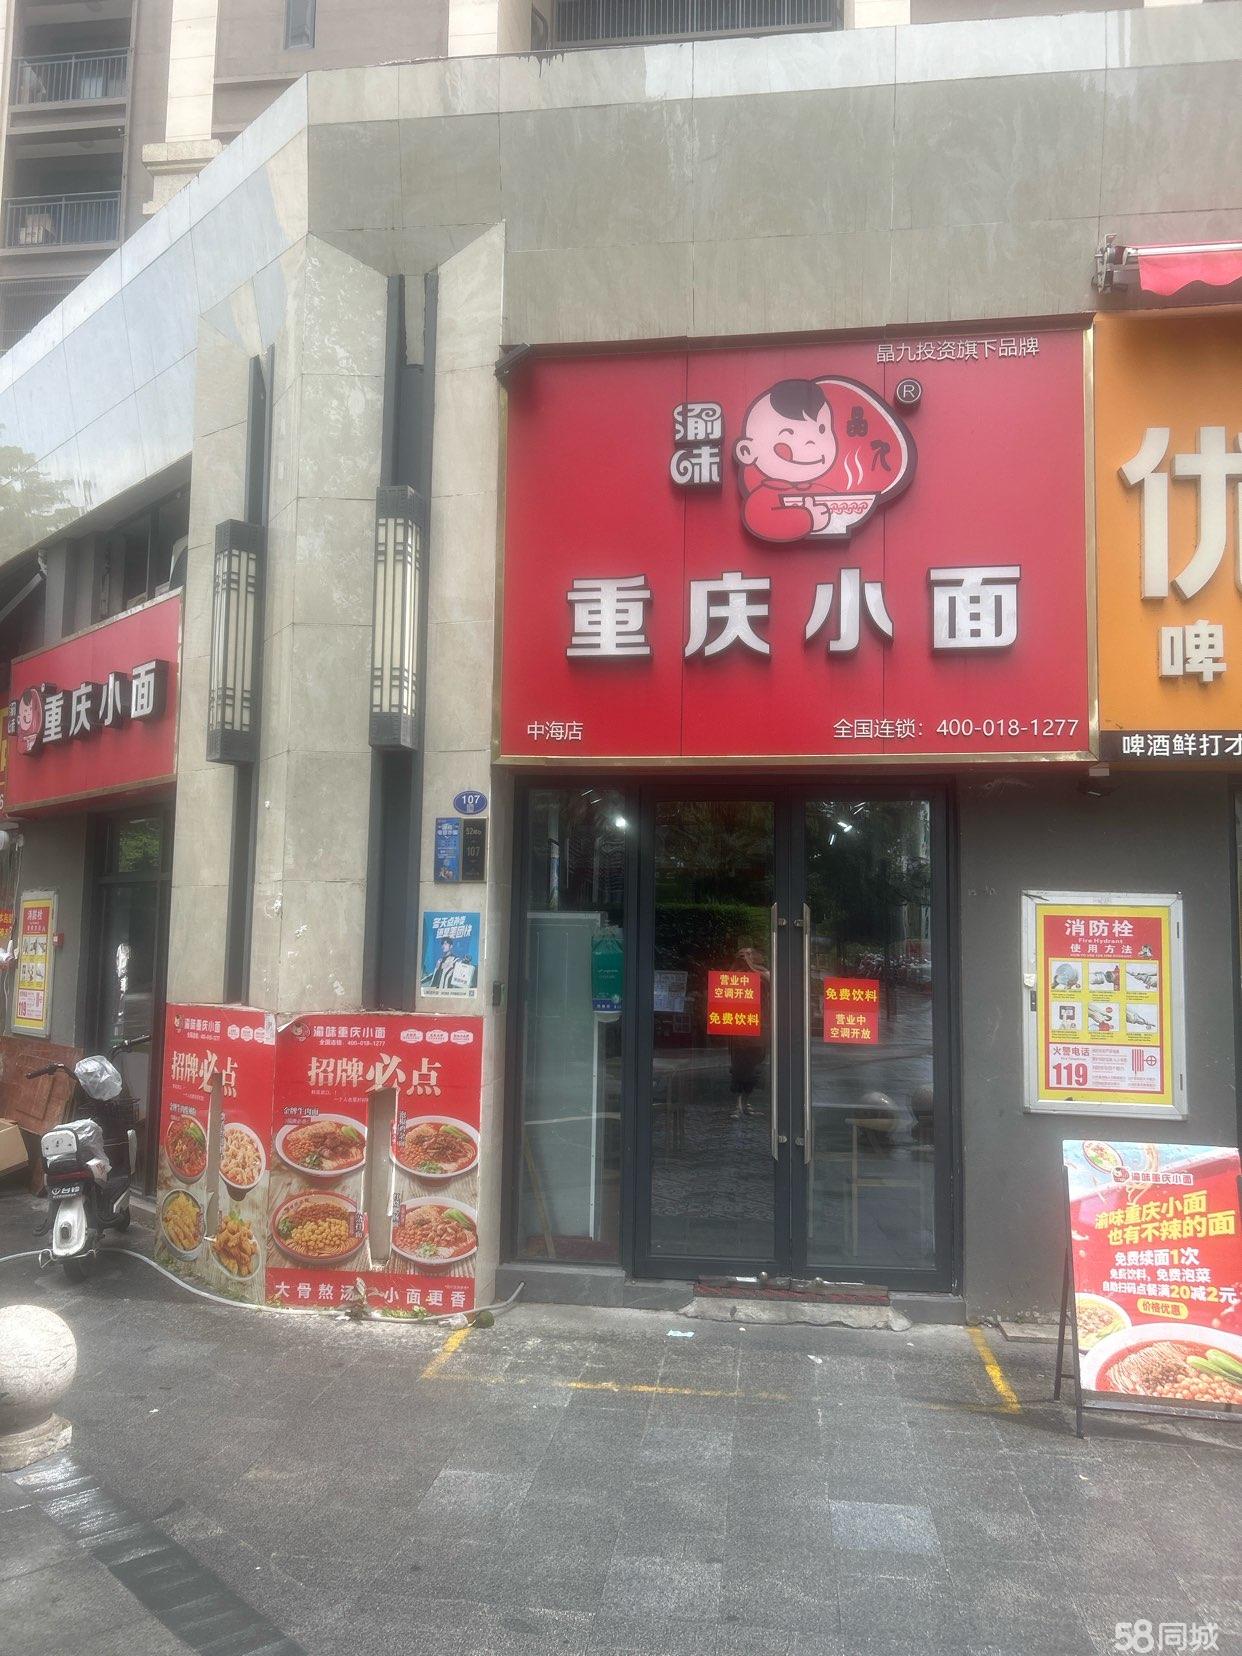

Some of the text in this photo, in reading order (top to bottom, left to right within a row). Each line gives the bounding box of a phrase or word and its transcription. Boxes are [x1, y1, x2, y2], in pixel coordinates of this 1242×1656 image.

[876, 337, 1041, 363] 晶九投资旗下品牌
[566, 567, 1021, 658] 重庆小面
[1159, 618, 1227, 683] 啤
[43, 661, 156, 743] 重庆小面
[527, 721, 583, 741] 中海店
[462, 794, 480, 804] 107
[1064, 918, 1134, 937] 消防栓
[1070, 943, 1133, 954] 使用方法
[719, 974, 750, 986] 营业中
[714, 987, 754, 1000] 空调开放
[825, 987, 878, 1002] 免费饮料
[708, 1012, 760, 1026] 免费饮料
[835, 1014, 866, 1026] 营业中
[313, 1026, 386, 1038] 渝味重庆小面
[829, 1027, 872, 1039] 空调开放
[1053, 1046, 1090, 1057] 火警电话
[171, 1050, 239, 1098] 招牌必点
[307, 1052, 442, 1097] 招牌必点
[1052, 1062, 1088, 1086] 119
[1095, 1191, 1207, 1229] 渝味重庆小面
[1108, 1211, 1236, 1245] 也有不辣的面
[275, 1281, 467, 1308] 大骨熬汤 小面更香
[1142, 1302, 1181, 1316] 价格优惠
